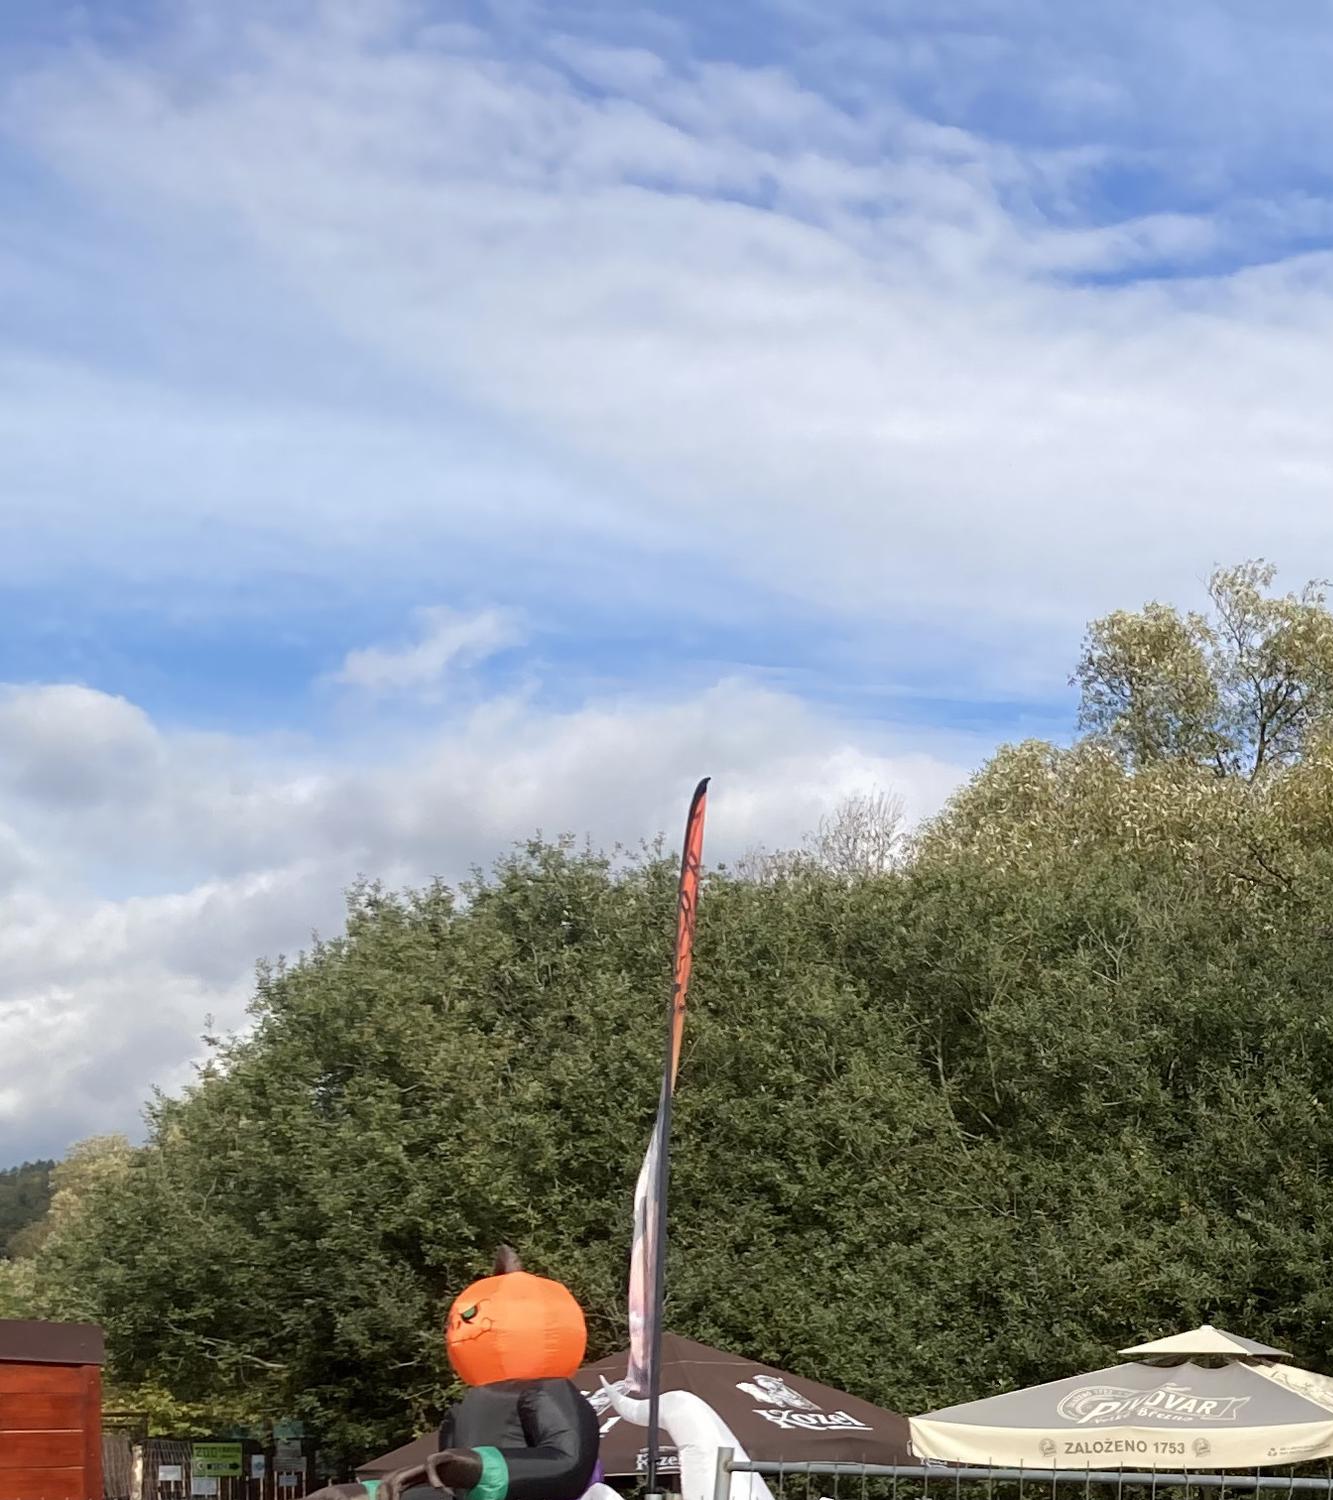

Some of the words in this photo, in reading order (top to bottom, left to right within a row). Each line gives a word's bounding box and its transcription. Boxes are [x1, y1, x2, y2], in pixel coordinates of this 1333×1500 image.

[1077, 1390, 1218, 1424] PIVOVAR
[753, 1409, 870, 1430] Kozel
[1064, 1438, 1148, 1454] ZALOŽENO
[1153, 1441, 1185, 1454] 1753
